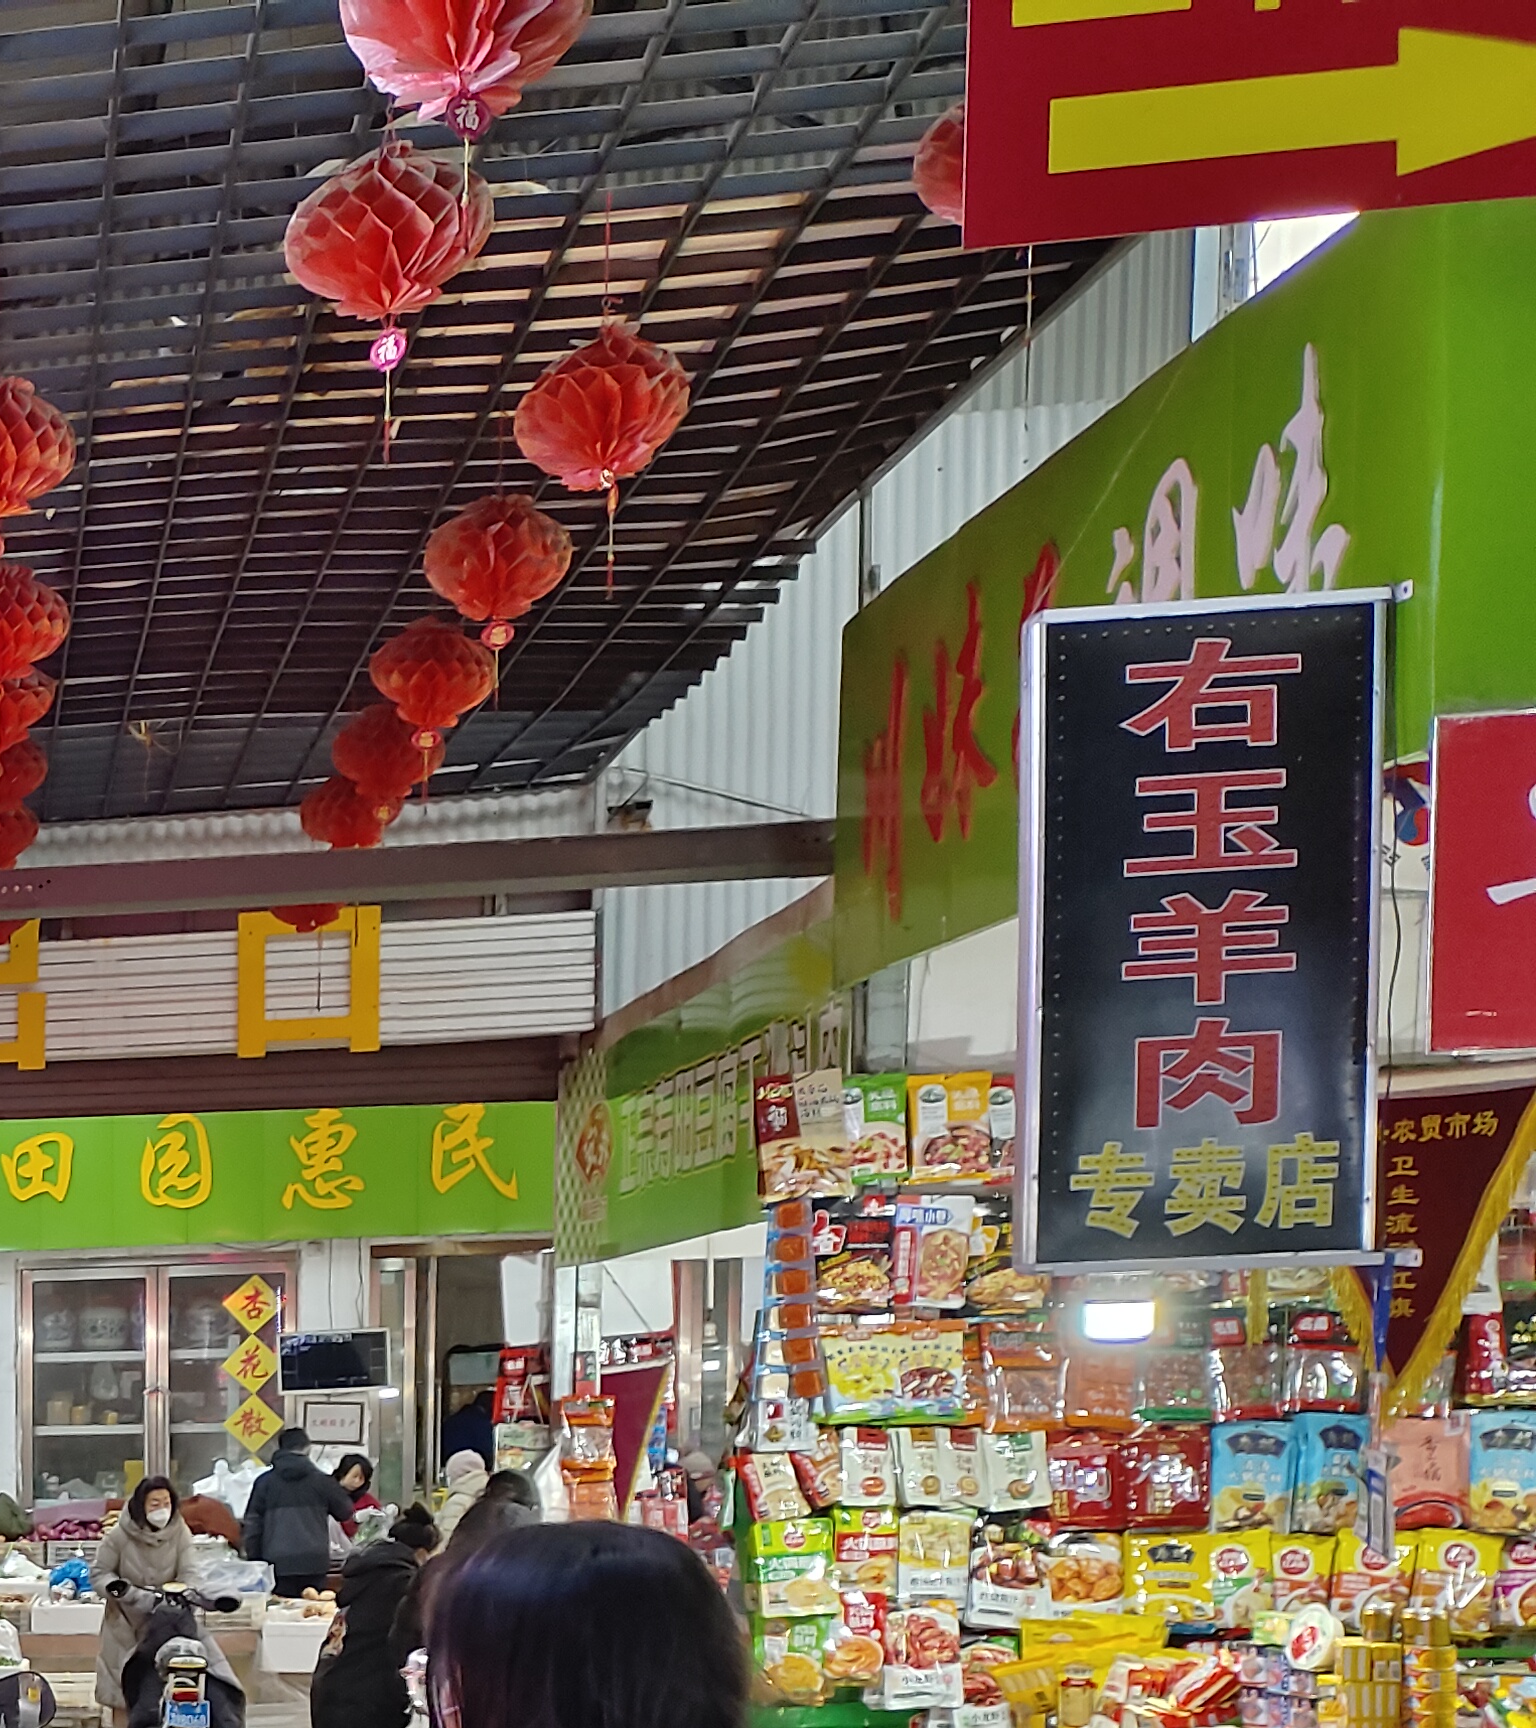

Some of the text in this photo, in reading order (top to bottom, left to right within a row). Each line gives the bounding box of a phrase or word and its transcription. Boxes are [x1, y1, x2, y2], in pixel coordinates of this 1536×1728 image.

[455, 102, 481, 133] 福
[1116, 636, 1303, 1130] 右玉羊肉
[1069, 1130, 1341, 1239] 专卖店
